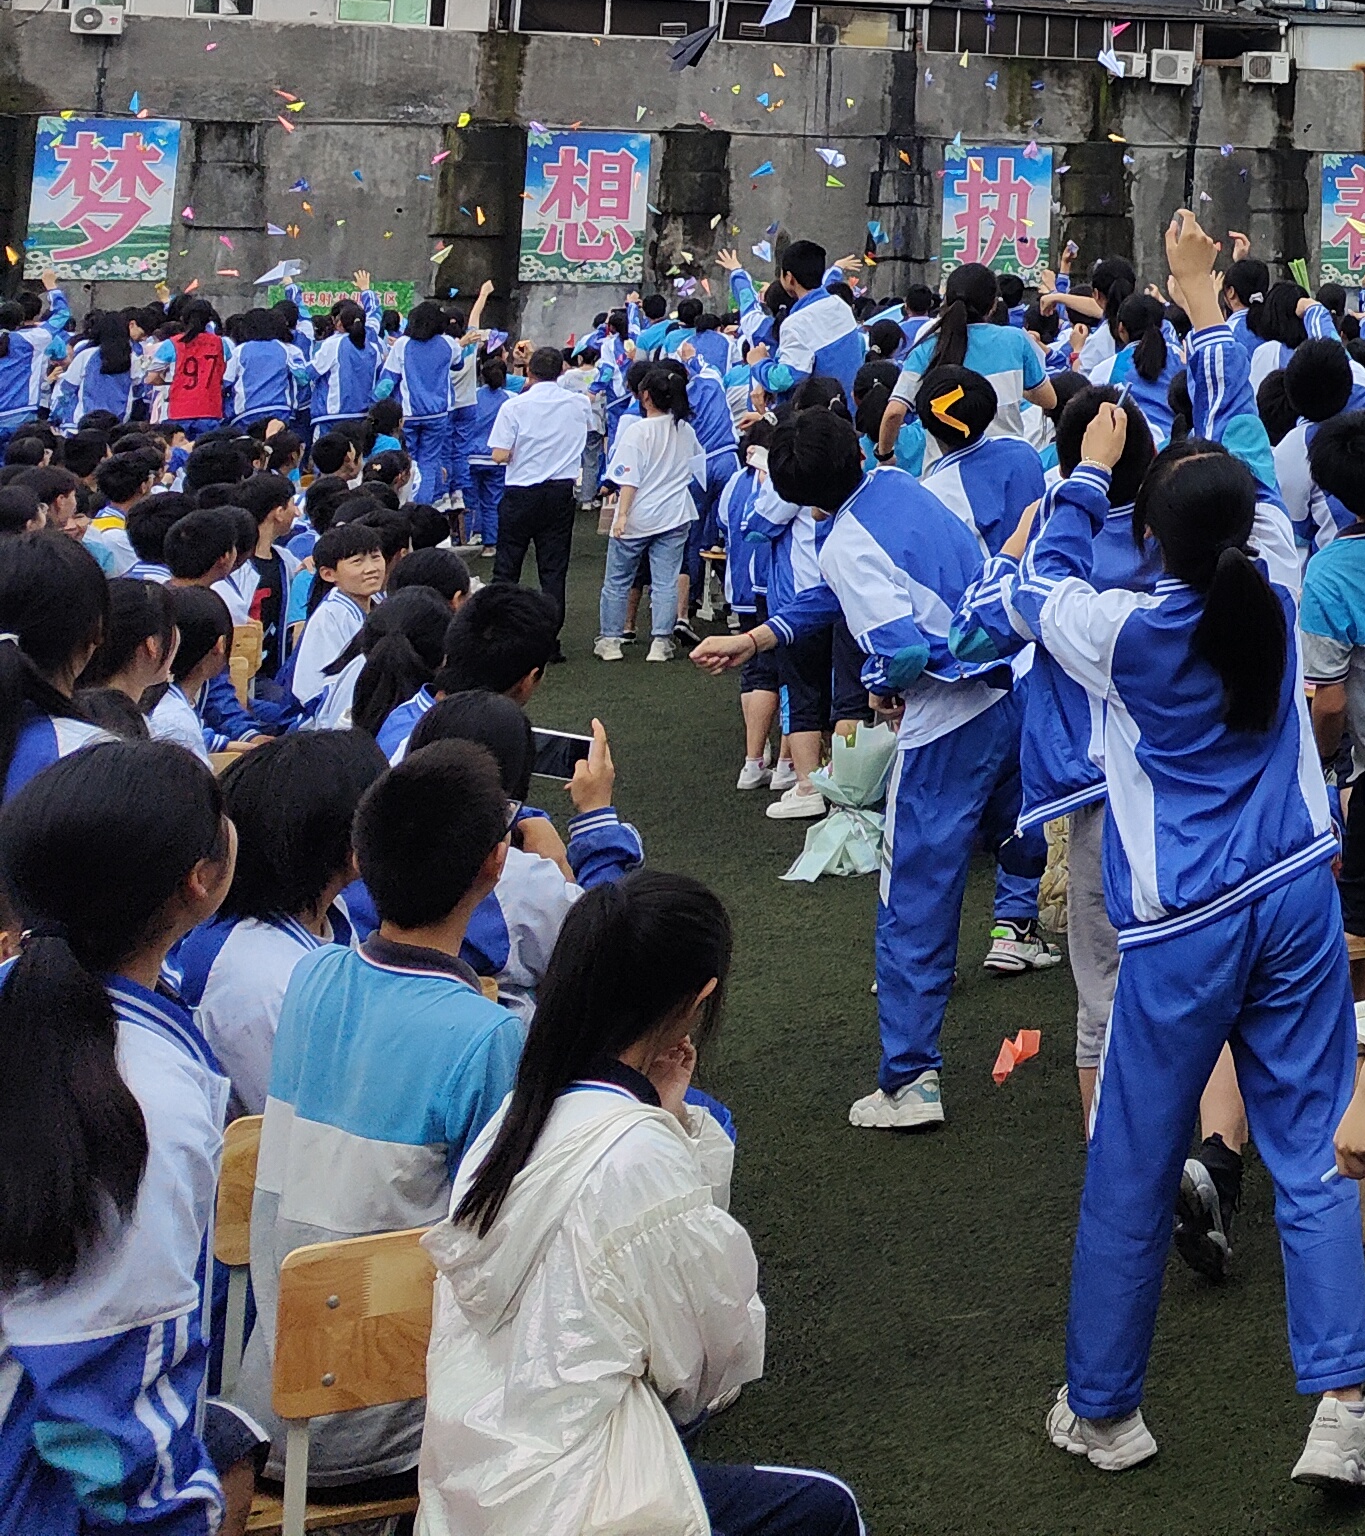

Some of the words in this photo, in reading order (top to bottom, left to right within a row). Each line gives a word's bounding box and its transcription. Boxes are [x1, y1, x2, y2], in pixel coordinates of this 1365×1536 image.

[47, 132, 165, 262] 梦
[537, 146, 638, 262] 想
[954, 157, 1040, 268] 执
[183, 354, 218, 390] 97
